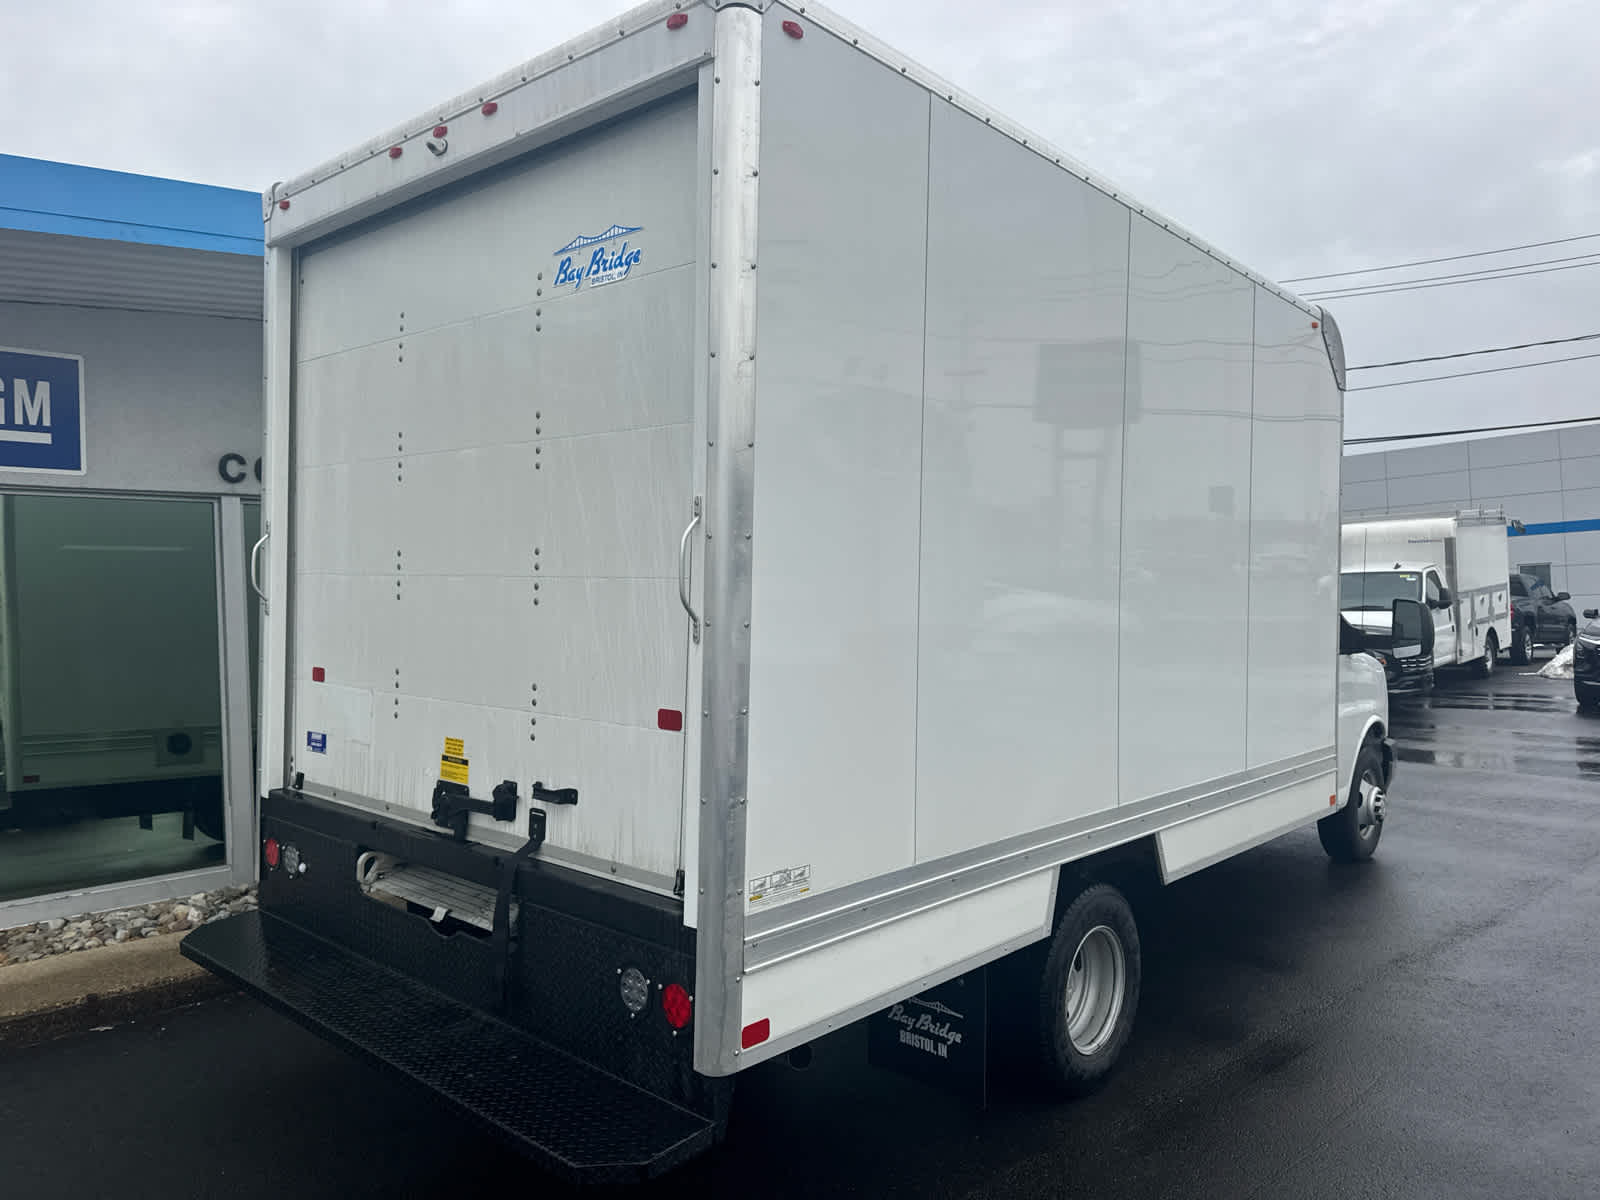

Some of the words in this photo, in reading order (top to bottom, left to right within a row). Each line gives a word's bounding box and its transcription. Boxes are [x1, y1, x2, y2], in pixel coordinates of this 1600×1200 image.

[554, 256, 584, 288] Bay
[586, 241, 640, 277] Bridge
[0, 378, 51, 427] M
[888, 1003, 916, 1031] Bay
[915, 1013, 962, 1045] Bridge
[938, 1042, 948, 1059] IN
